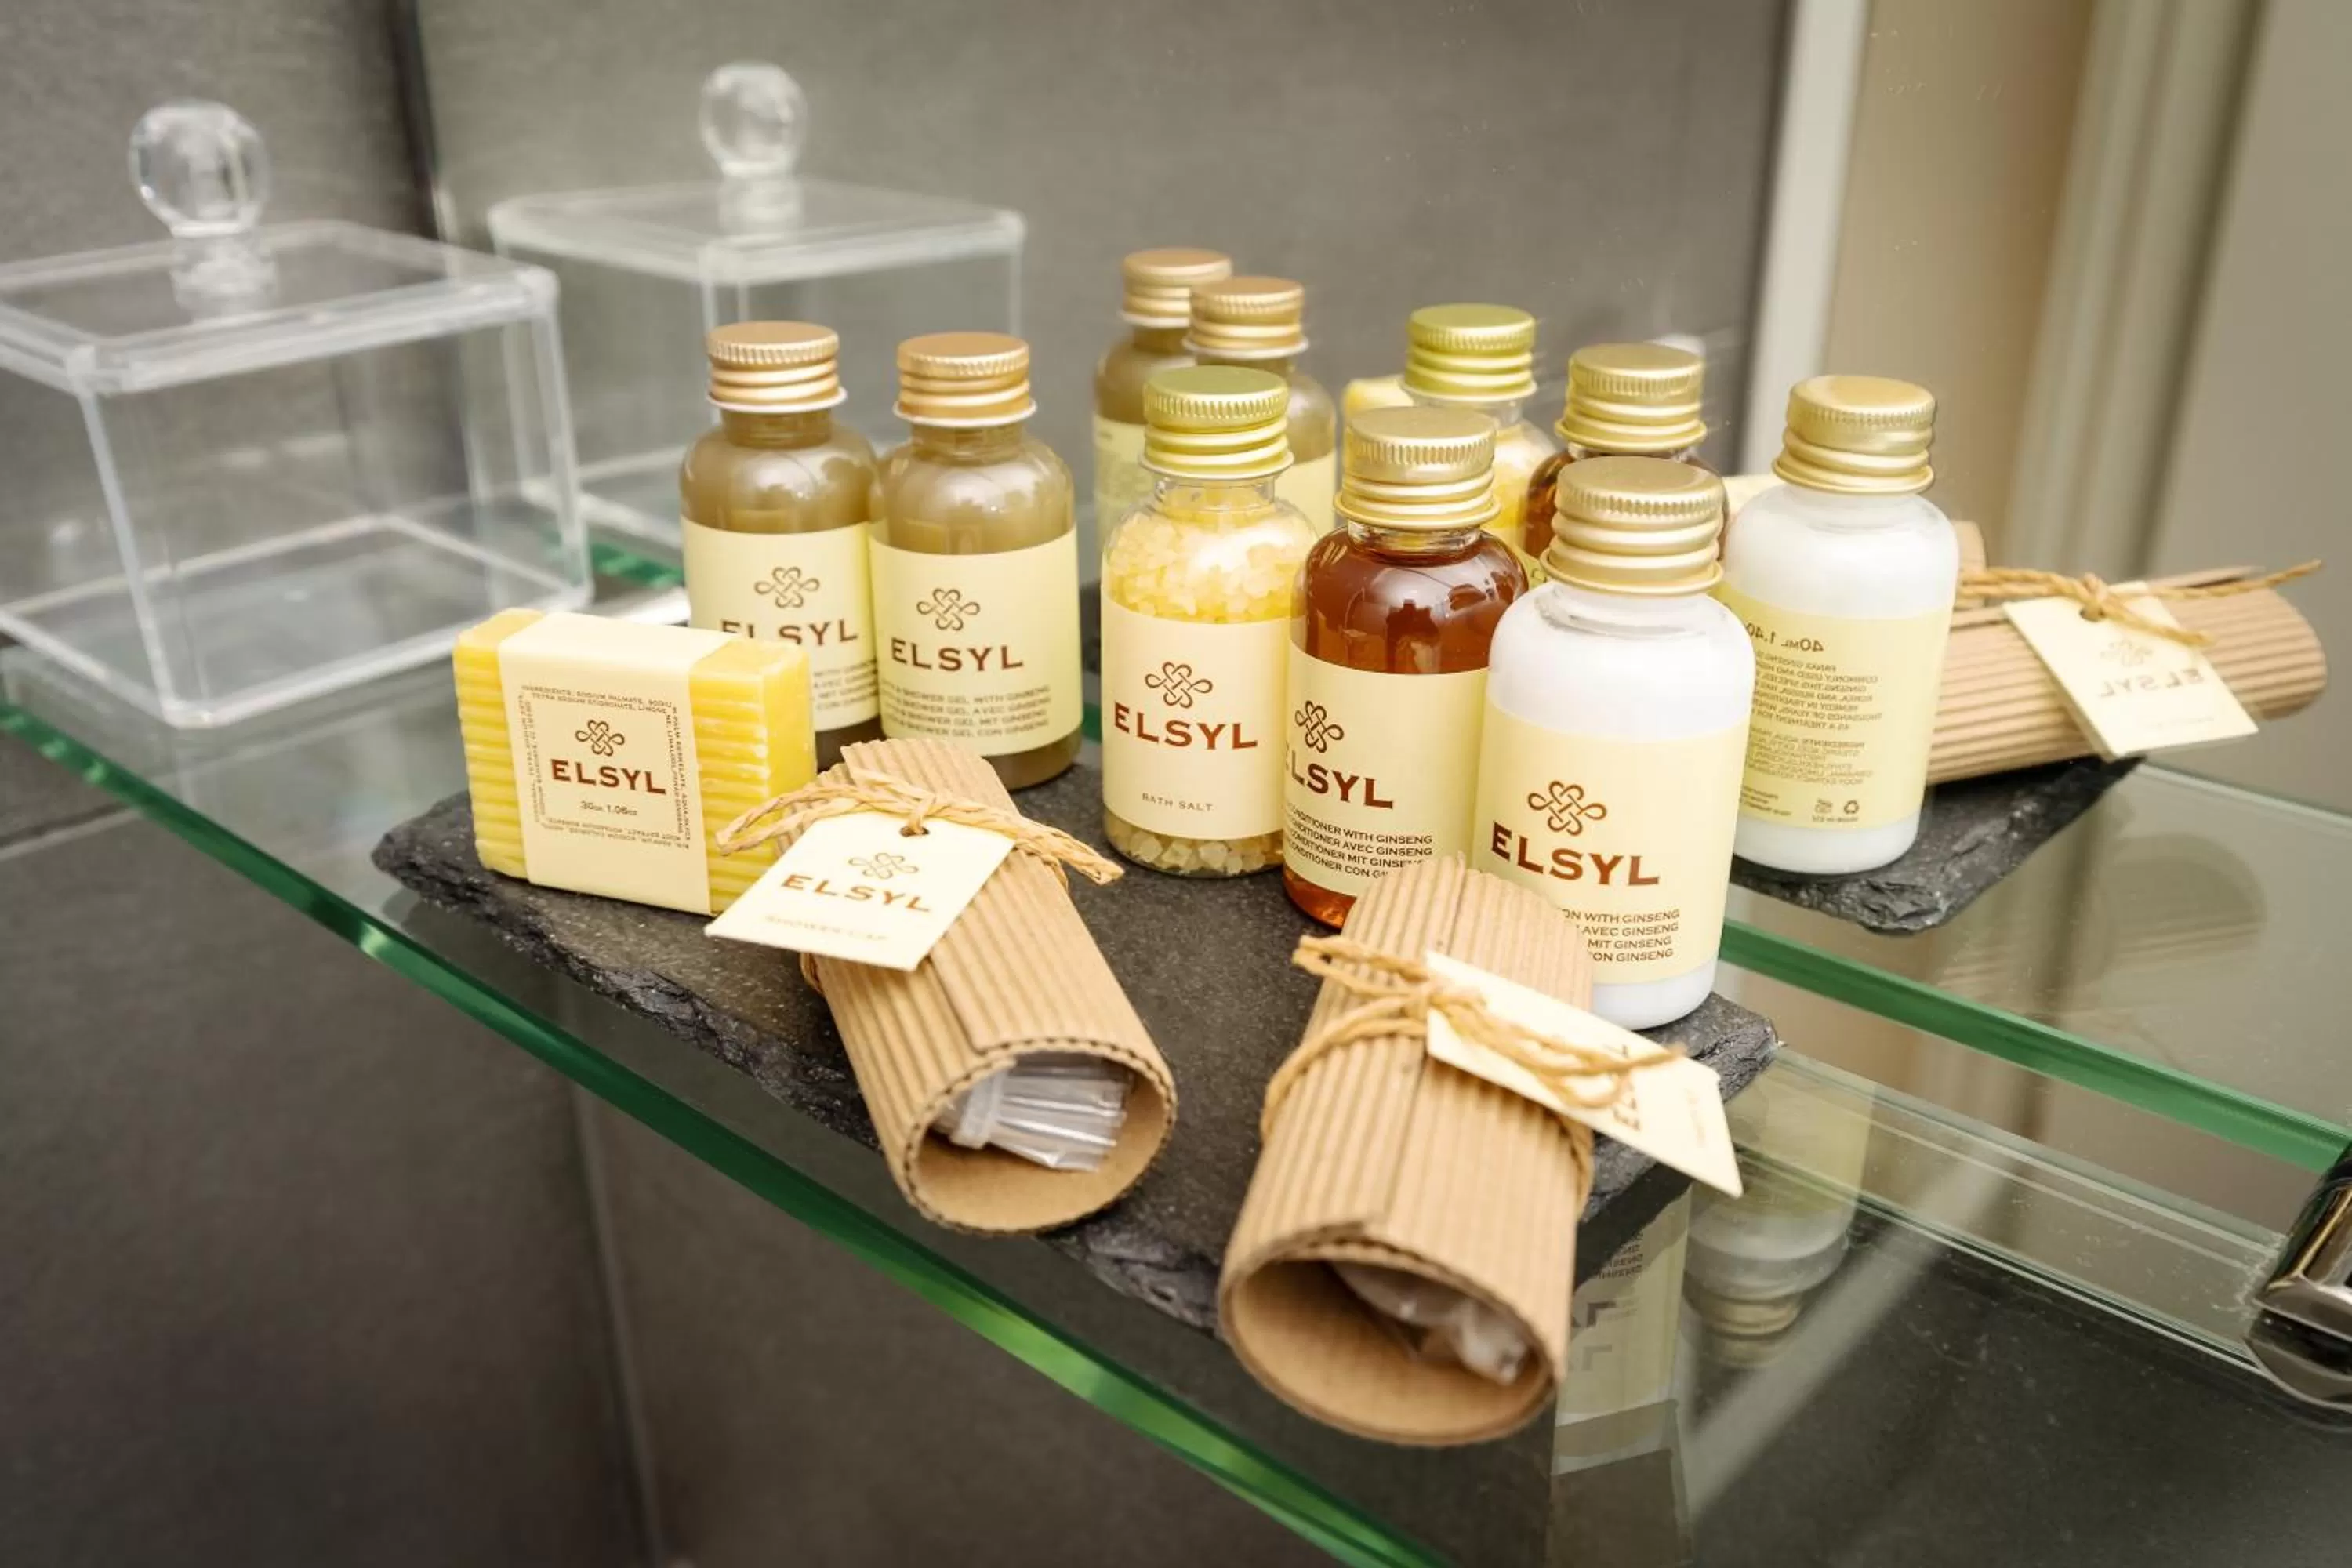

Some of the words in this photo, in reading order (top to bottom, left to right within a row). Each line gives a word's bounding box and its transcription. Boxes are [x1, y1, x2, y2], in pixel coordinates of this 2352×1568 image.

[891, 637, 1024, 672] ELSYL
[1114, 702, 1258, 750] ELSYL
[550, 758, 666, 795] ELSYL
[1285, 741, 1393, 809] LSYL
[1142, 792, 1174, 808] BATH
[1178, 800, 1214, 812] SALT
[1343, 829, 1374, 842] WITH
[1376, 834, 1433, 845] GINSENG
[1342, 841, 1374, 854] AVEC
[1376, 846, 1433, 857] GINSENG
[1490, 821, 1660, 887] ELSYL
[1347, 854, 1368, 865] MIT
[1345, 865, 1370, 877] CON
[781, 873, 932, 913] ELSYL
[1584, 912, 1619, 924] WITH
[1622, 909, 1680, 924] GINSENG
[1581, 926, 1619, 936] AVEC
[1621, 922, 1679, 937] GINSENG
[1588, 938, 1613, 949] MIT
[1614, 935, 1672, 949] GINSENG
[1588, 950, 1613, 962] ON
[1616, 948, 1674, 962] GINSENG
